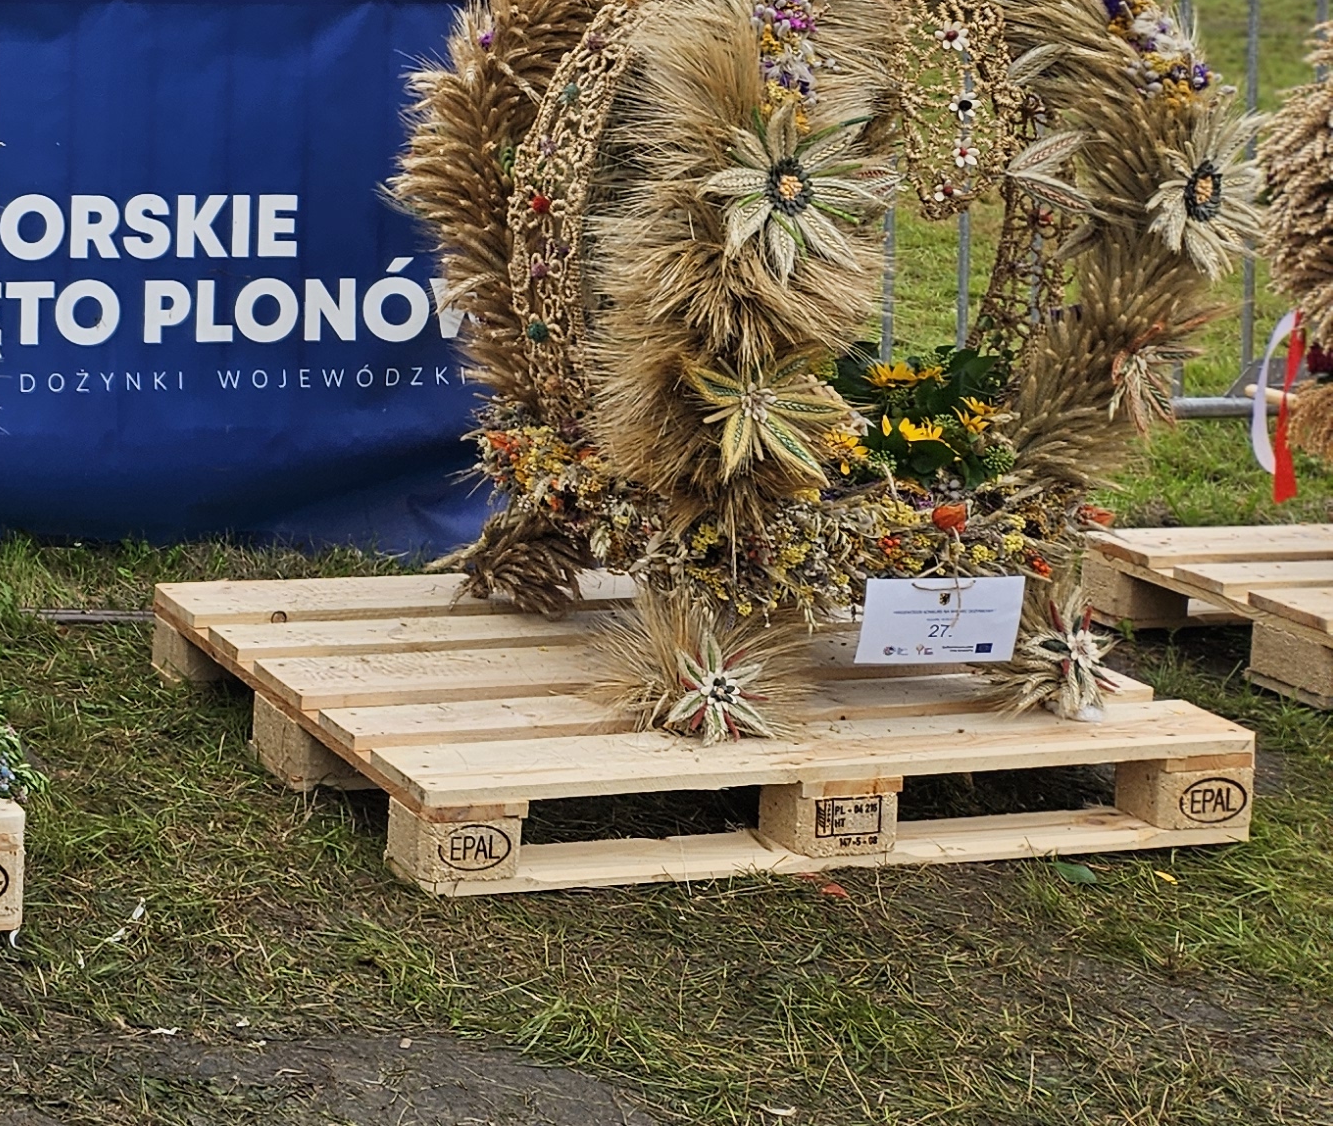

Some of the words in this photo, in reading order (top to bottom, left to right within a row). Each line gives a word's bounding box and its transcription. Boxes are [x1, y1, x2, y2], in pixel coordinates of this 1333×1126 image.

[20, 368, 183, 393] DOŻYNKI
[217, 363, 489, 390] WOJEWÓDZKI
[928, 624, 953, 638] 27.
[1190, 786, 1237, 814] EPAL
[834, 818, 846, 827] HT
[450, 835, 501, 861] EPAL
